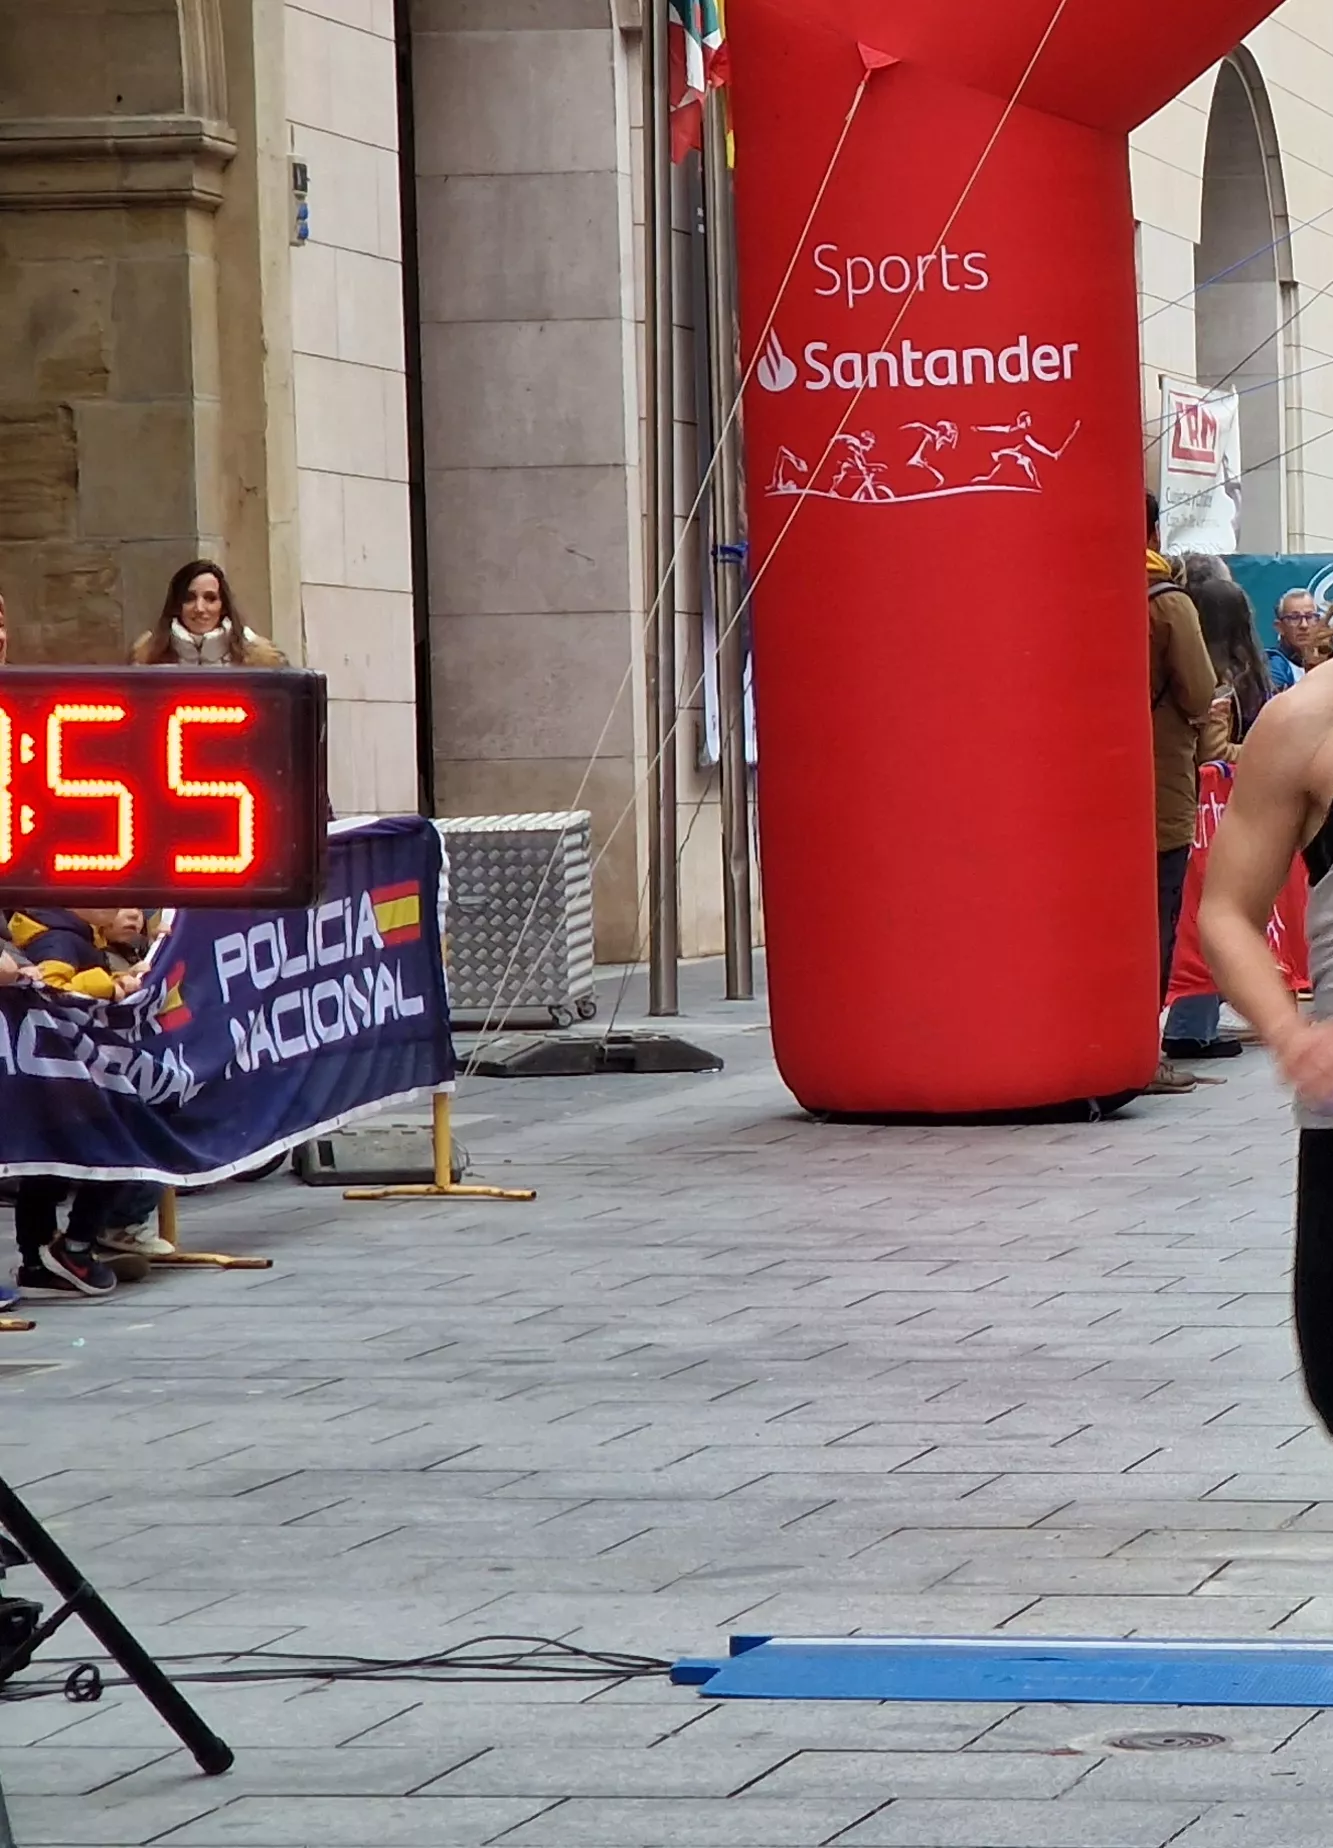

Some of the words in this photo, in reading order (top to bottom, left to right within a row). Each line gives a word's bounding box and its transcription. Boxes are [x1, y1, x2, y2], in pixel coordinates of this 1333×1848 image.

[813, 244, 989, 307] Sports
[804, 335, 1079, 391] Santander
[224, 959, 425, 1081] NACIONAL
